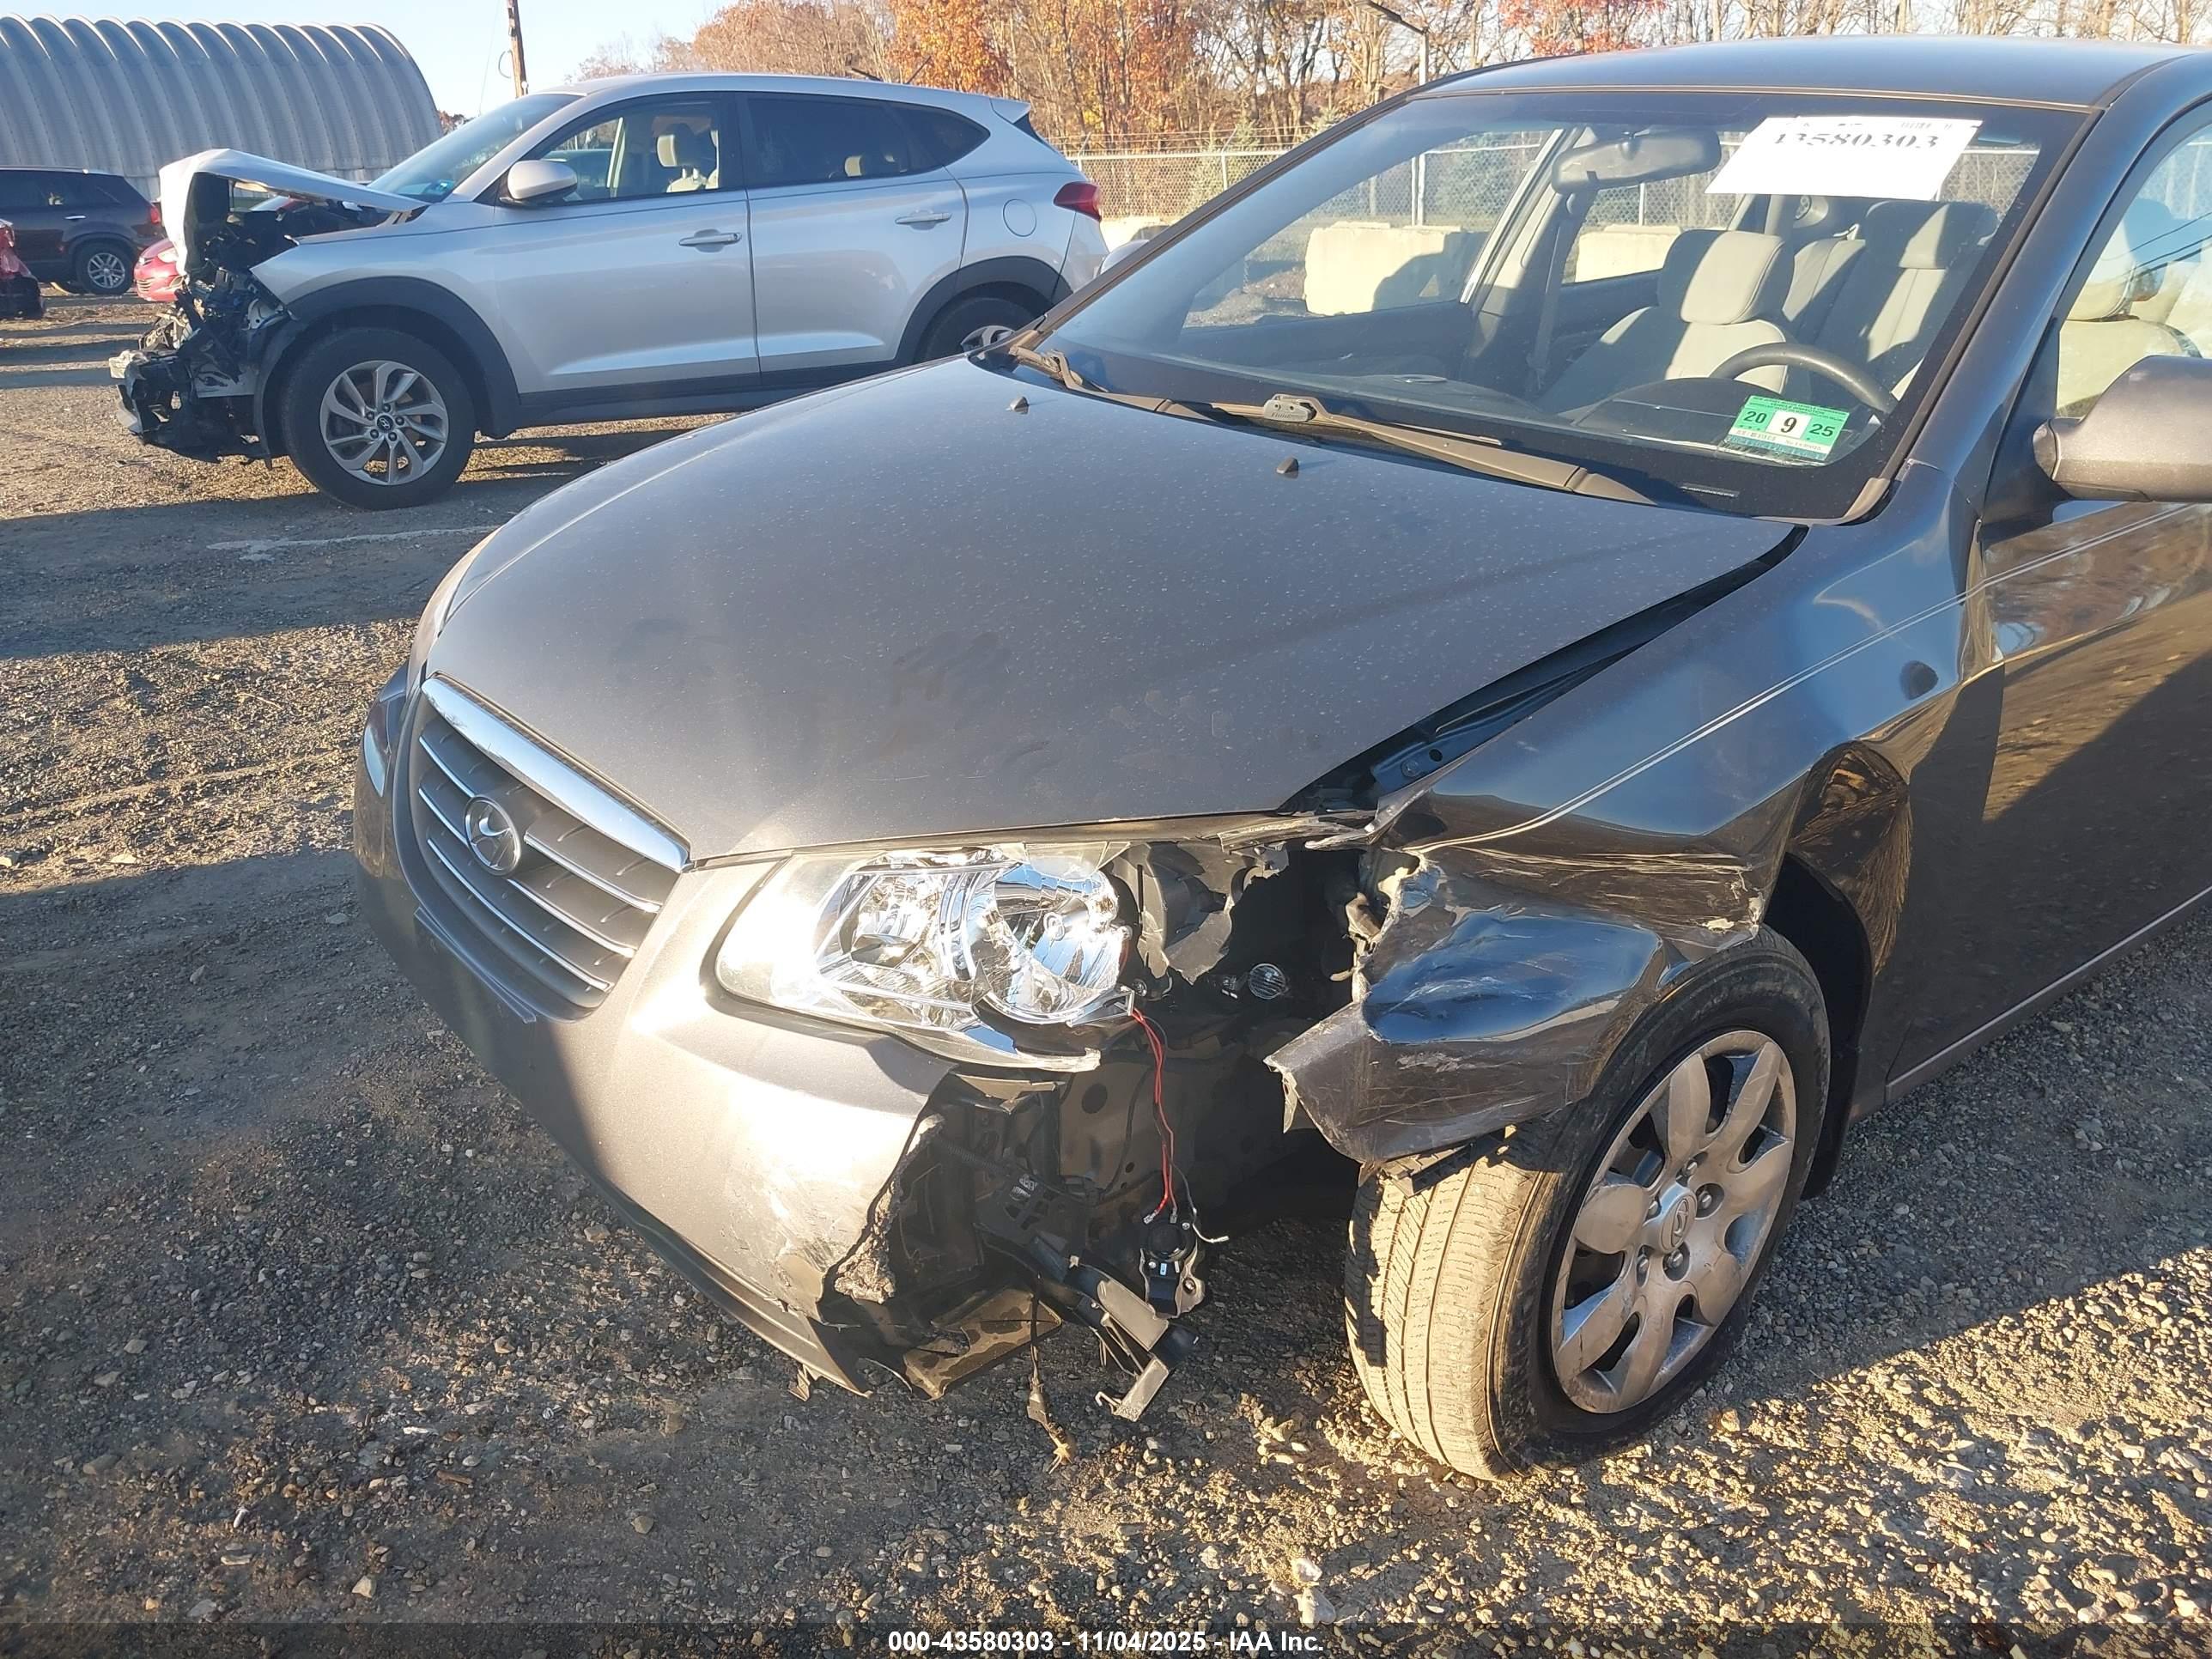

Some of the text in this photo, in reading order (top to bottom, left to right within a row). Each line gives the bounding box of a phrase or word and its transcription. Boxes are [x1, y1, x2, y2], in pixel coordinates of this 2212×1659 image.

[1743, 411, 1767, 424] 20
[1780, 416, 1797, 433] 9
[1809, 423, 1835, 437] 25
